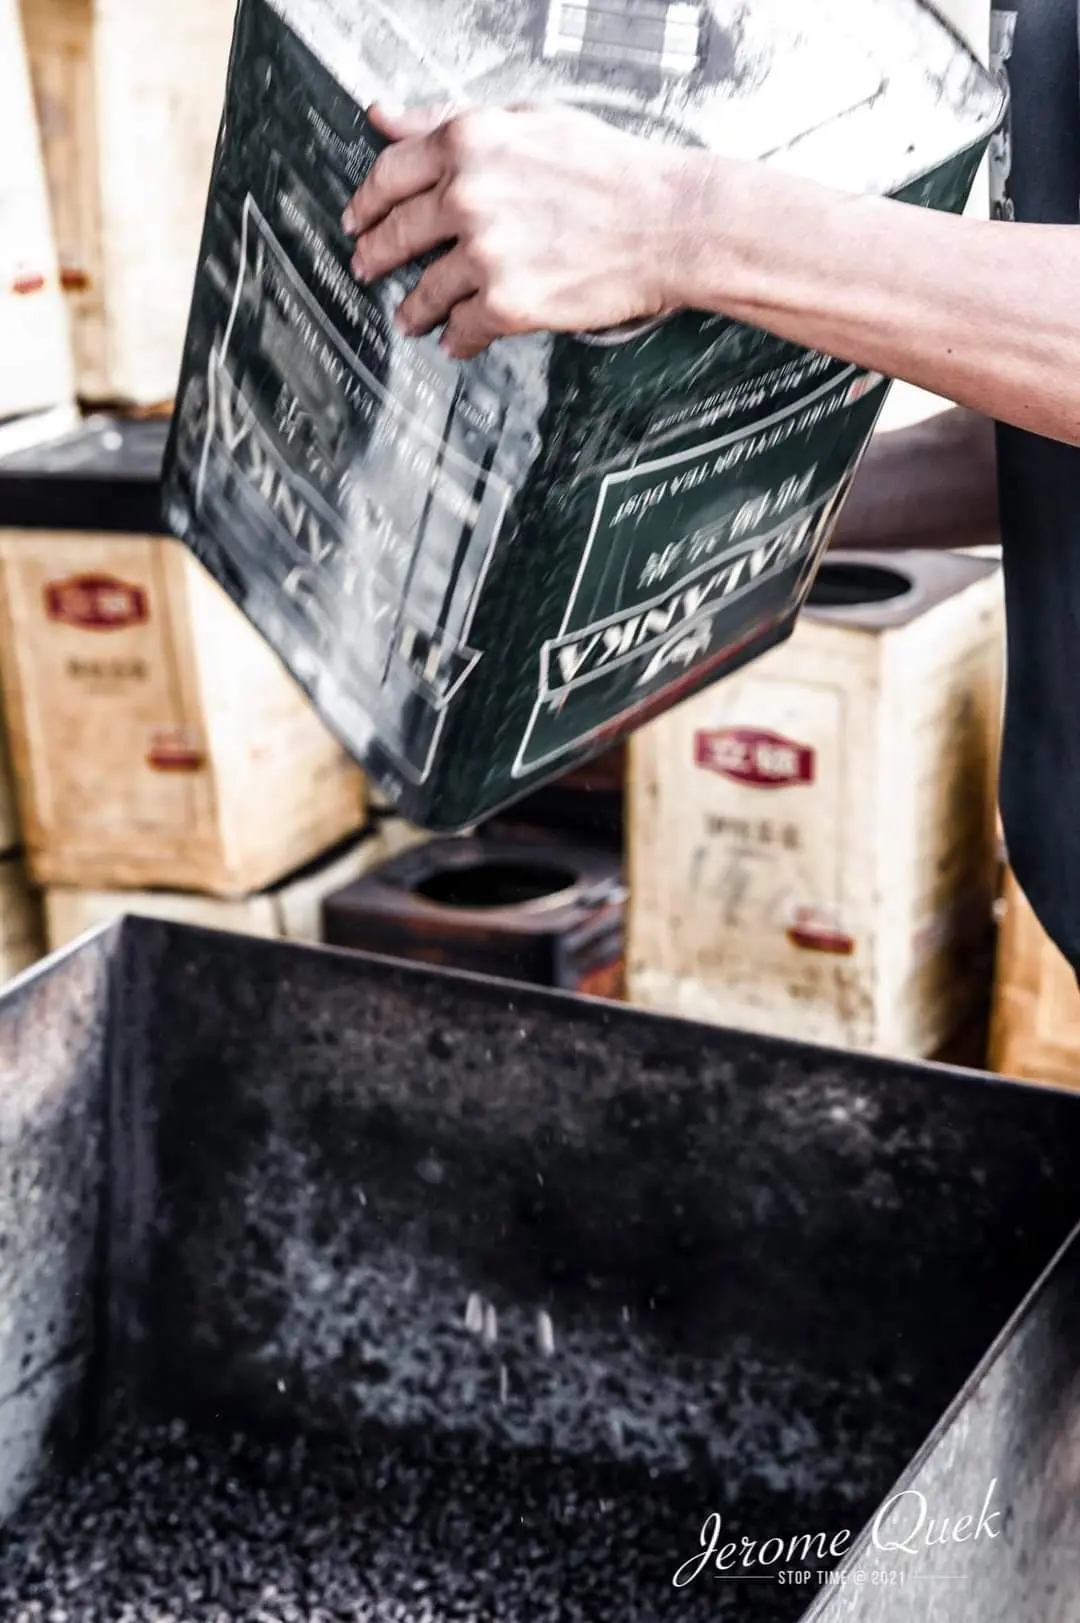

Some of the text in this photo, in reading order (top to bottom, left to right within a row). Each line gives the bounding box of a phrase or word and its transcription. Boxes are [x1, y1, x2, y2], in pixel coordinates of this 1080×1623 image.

[709, 417, 796, 473] CEYLON
[666, 461, 709, 497] TEA
[609, 480, 667, 527] DUST
